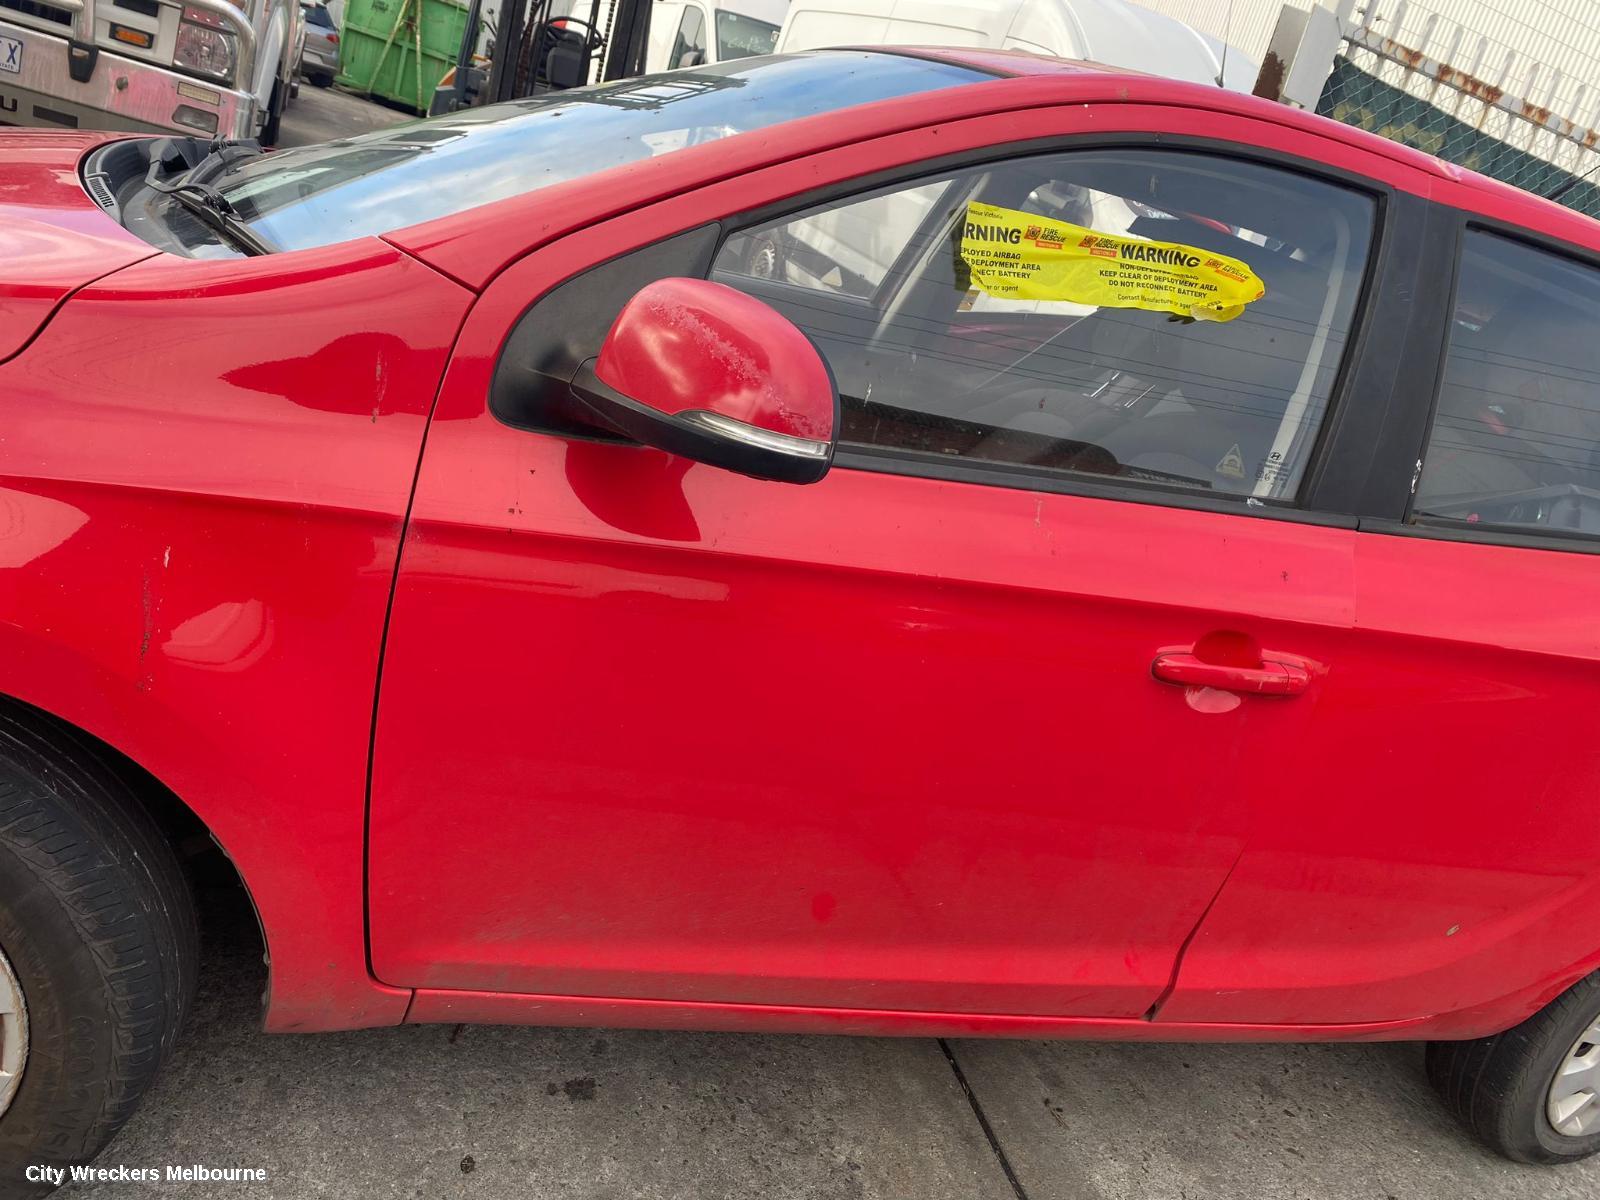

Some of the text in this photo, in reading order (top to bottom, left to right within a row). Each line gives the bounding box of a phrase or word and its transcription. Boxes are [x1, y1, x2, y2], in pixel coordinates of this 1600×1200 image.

[993, 250, 1021, 260] AIRBAG
[1121, 244, 1200, 267] WARNING
[971, 258, 1020, 269] DEPLOYMENT
[1021, 262, 1041, 271] AREA
[998, 269, 1031, 279] BATTERY
[1099, 268, 1117, 277] KEEP
[1119, 271, 1142, 280] CLEAR
[1153, 275, 1199, 289] DEPLOYMENT
[1199, 284, 1218, 293] AREA
[1108, 279, 1208, 300] DO NOT RECONNECT BATTERY
